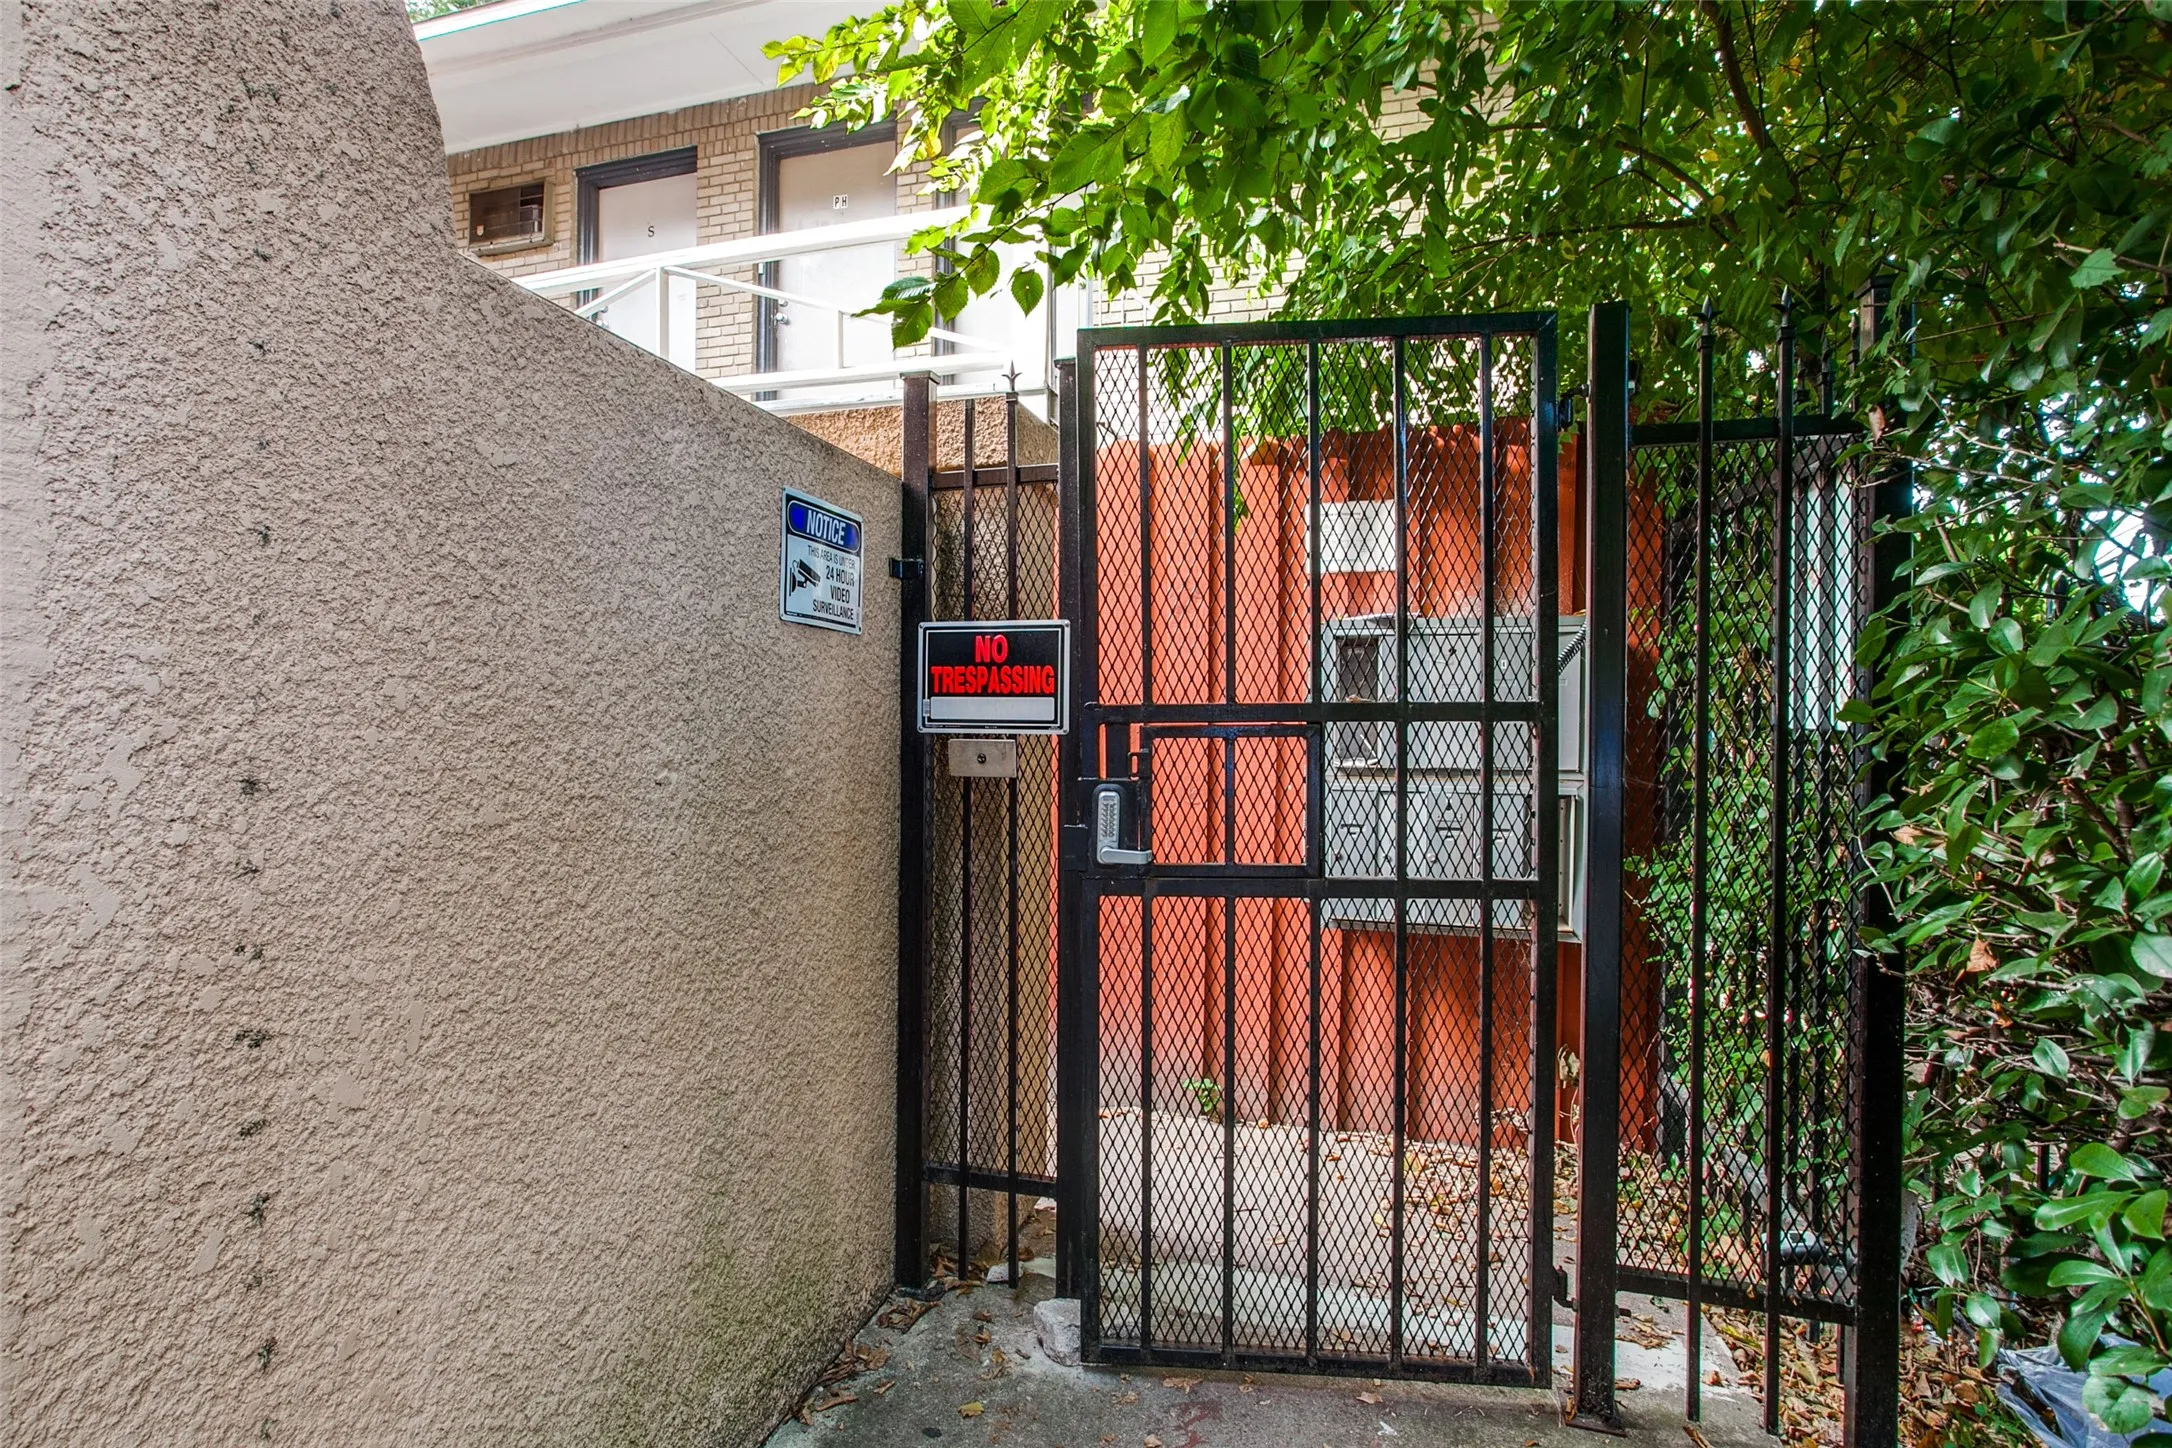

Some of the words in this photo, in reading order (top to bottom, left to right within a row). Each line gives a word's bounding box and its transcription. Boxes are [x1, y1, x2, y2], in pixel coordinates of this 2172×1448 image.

[806, 509, 846, 545] NOTICE
[808, 545, 819, 559] THIS
[820, 548, 833, 562] AREA
[833, 553, 838, 565] IS
[839, 555, 856, 570] UNDER
[826, 566, 834, 580] 24
[836, 567, 855, 587] HOUR
[830, 584, 850, 604] VIDEO
[812, 599, 854, 621] SURVEILLANCE
[975, 634, 1008, 663] NO
[930, 665, 1055, 693] TRESPASSING
